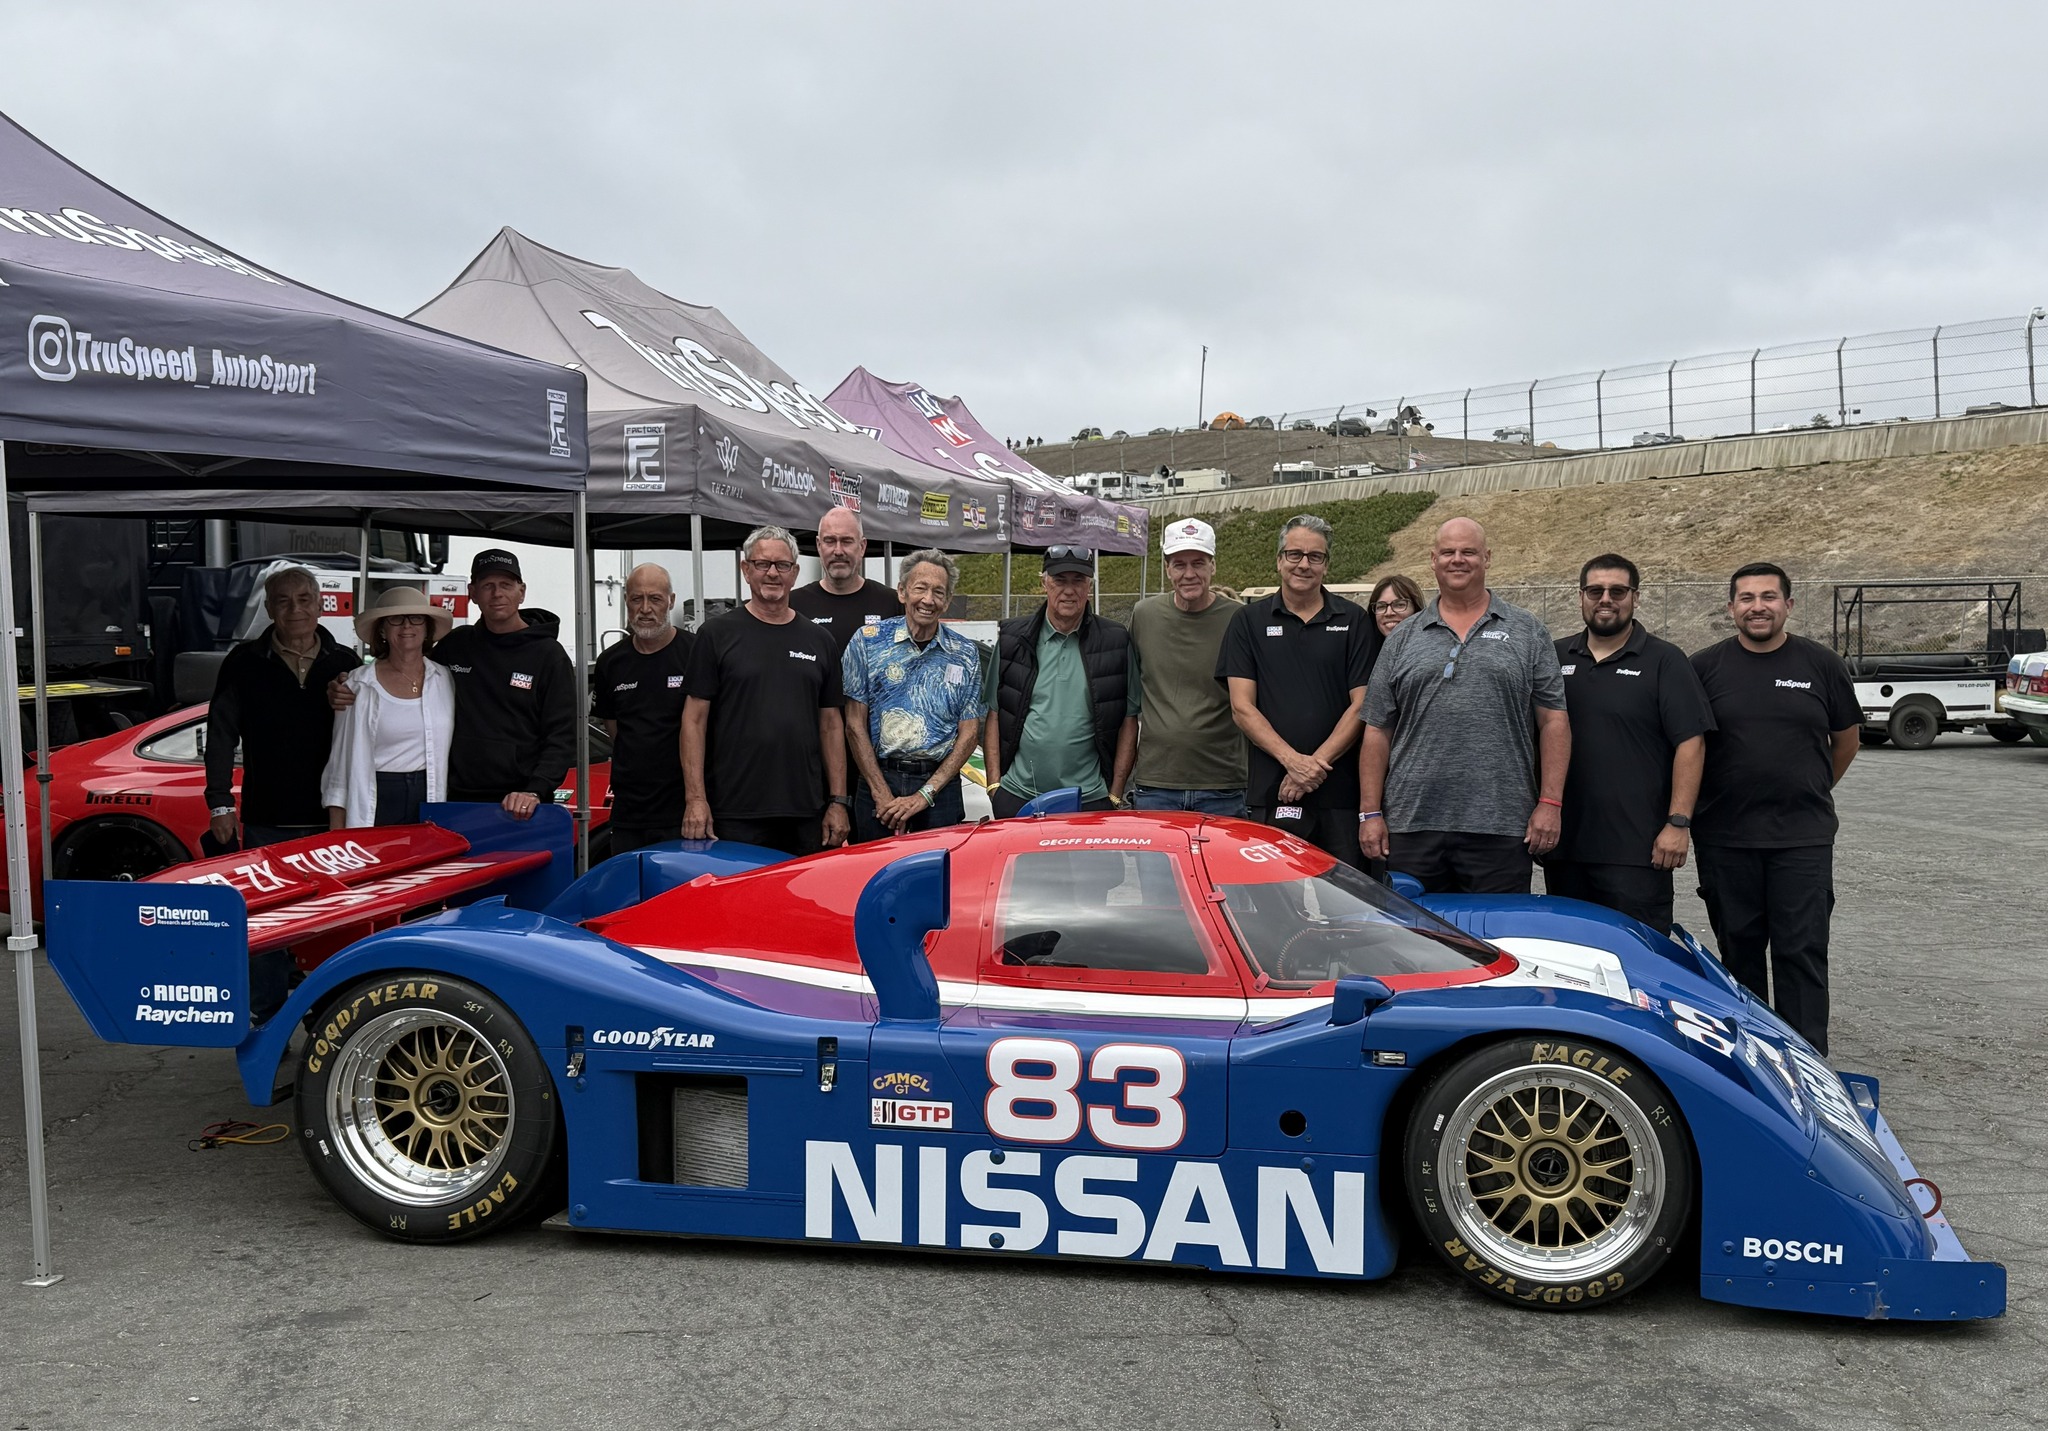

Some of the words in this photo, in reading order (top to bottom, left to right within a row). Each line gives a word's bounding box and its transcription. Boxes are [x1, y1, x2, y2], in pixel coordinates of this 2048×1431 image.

[75, 331, 316, 395] TruSpeed_AutoSport
[625, 425, 663, 435] FACTORY
[772, 463, 817, 497] FluidLogic
[789, 651, 817, 662] TruSpeed
[1774, 678, 1812, 690] TruSpeed
[85, 791, 153, 805] PIRELLI
[1039, 838, 1082, 846] GEOFF
[1239, 843, 1286, 863] GTP
[234, 860, 299, 892] ZX
[282, 840, 381, 876] TURBO
[157, 906, 209, 921] Chevron
[157, 919, 181, 927] Research
[191, 920, 221, 928] Technology
[154, 984, 218, 1003] RICOR
[135, 1004, 235, 1026] Raychem
[463, 1001, 485, 1015] SET
[498, 1039, 515, 1059] RR
[592, 1027, 716, 1051] GOODYEAR
[1530, 1042, 1633, 1086] EAGLE
[872, 1072, 931, 1093] CAMEL
[894, 1084, 910, 1095] GT
[984, 1037, 1186, 1151] 83
[897, 1105, 951, 1123] GTP
[1650, 1105, 1674, 1129] RF
[448, 1171, 519, 1231] EAGLE
[805, 1140, 1366, 1276] NISSAN
[1743, 1237, 1844, 1265] BOSCH
